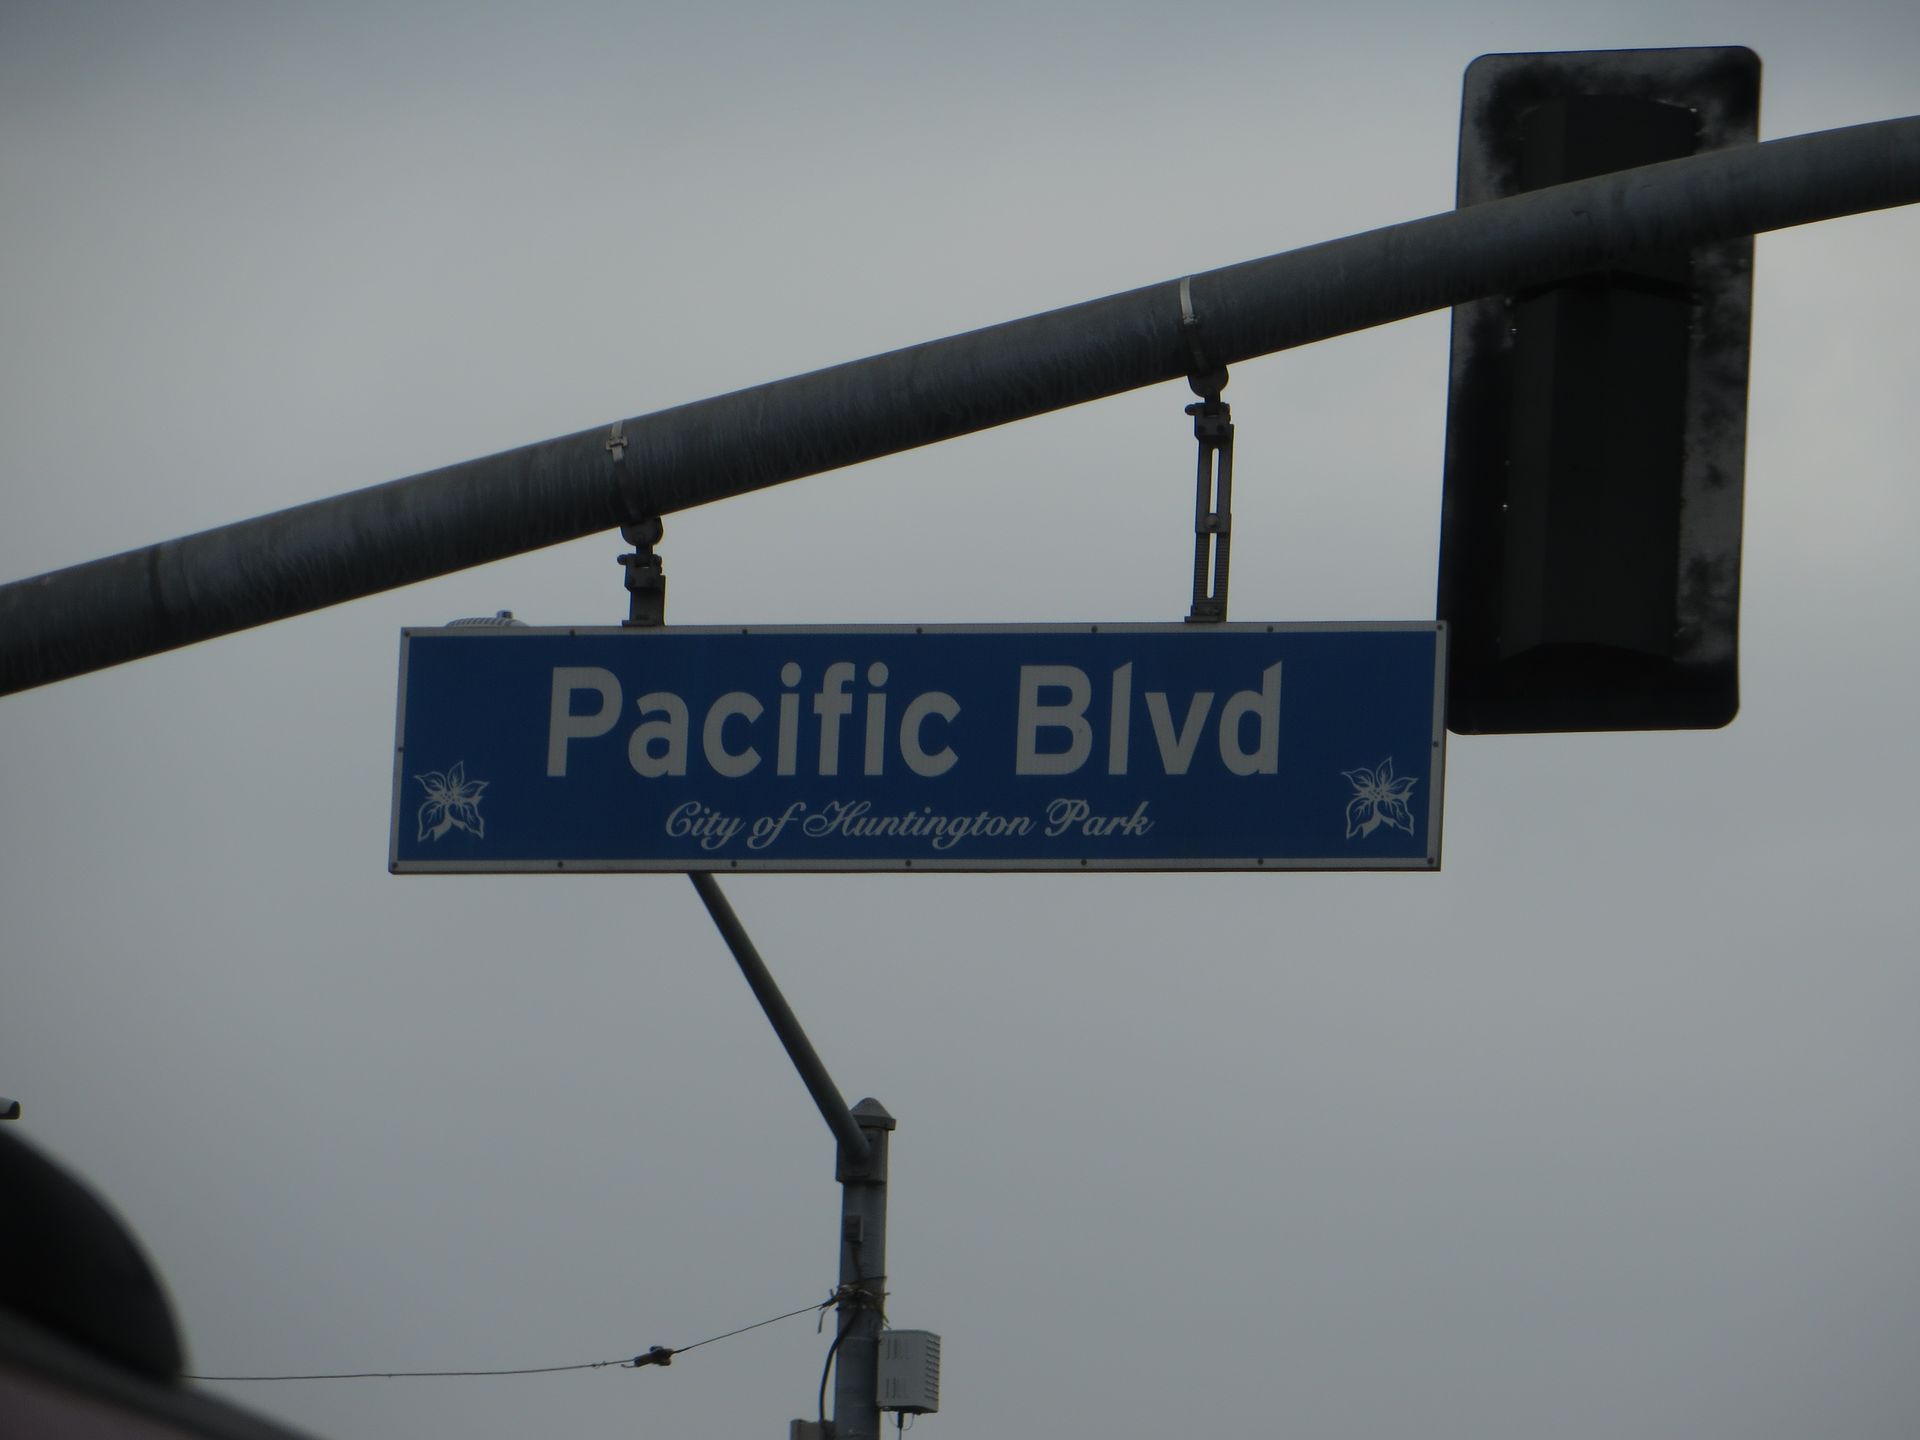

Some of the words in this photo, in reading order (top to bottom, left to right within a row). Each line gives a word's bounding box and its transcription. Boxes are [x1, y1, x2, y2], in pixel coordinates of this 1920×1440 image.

[547, 661, 961, 779] Pacific
[1015, 661, 1283, 778] Blvd
[665, 801, 744, 850] City
[746, 801, 806, 850] of
[803, 800, 1036, 850] Huntington
[1044, 798, 1155, 838] Park
